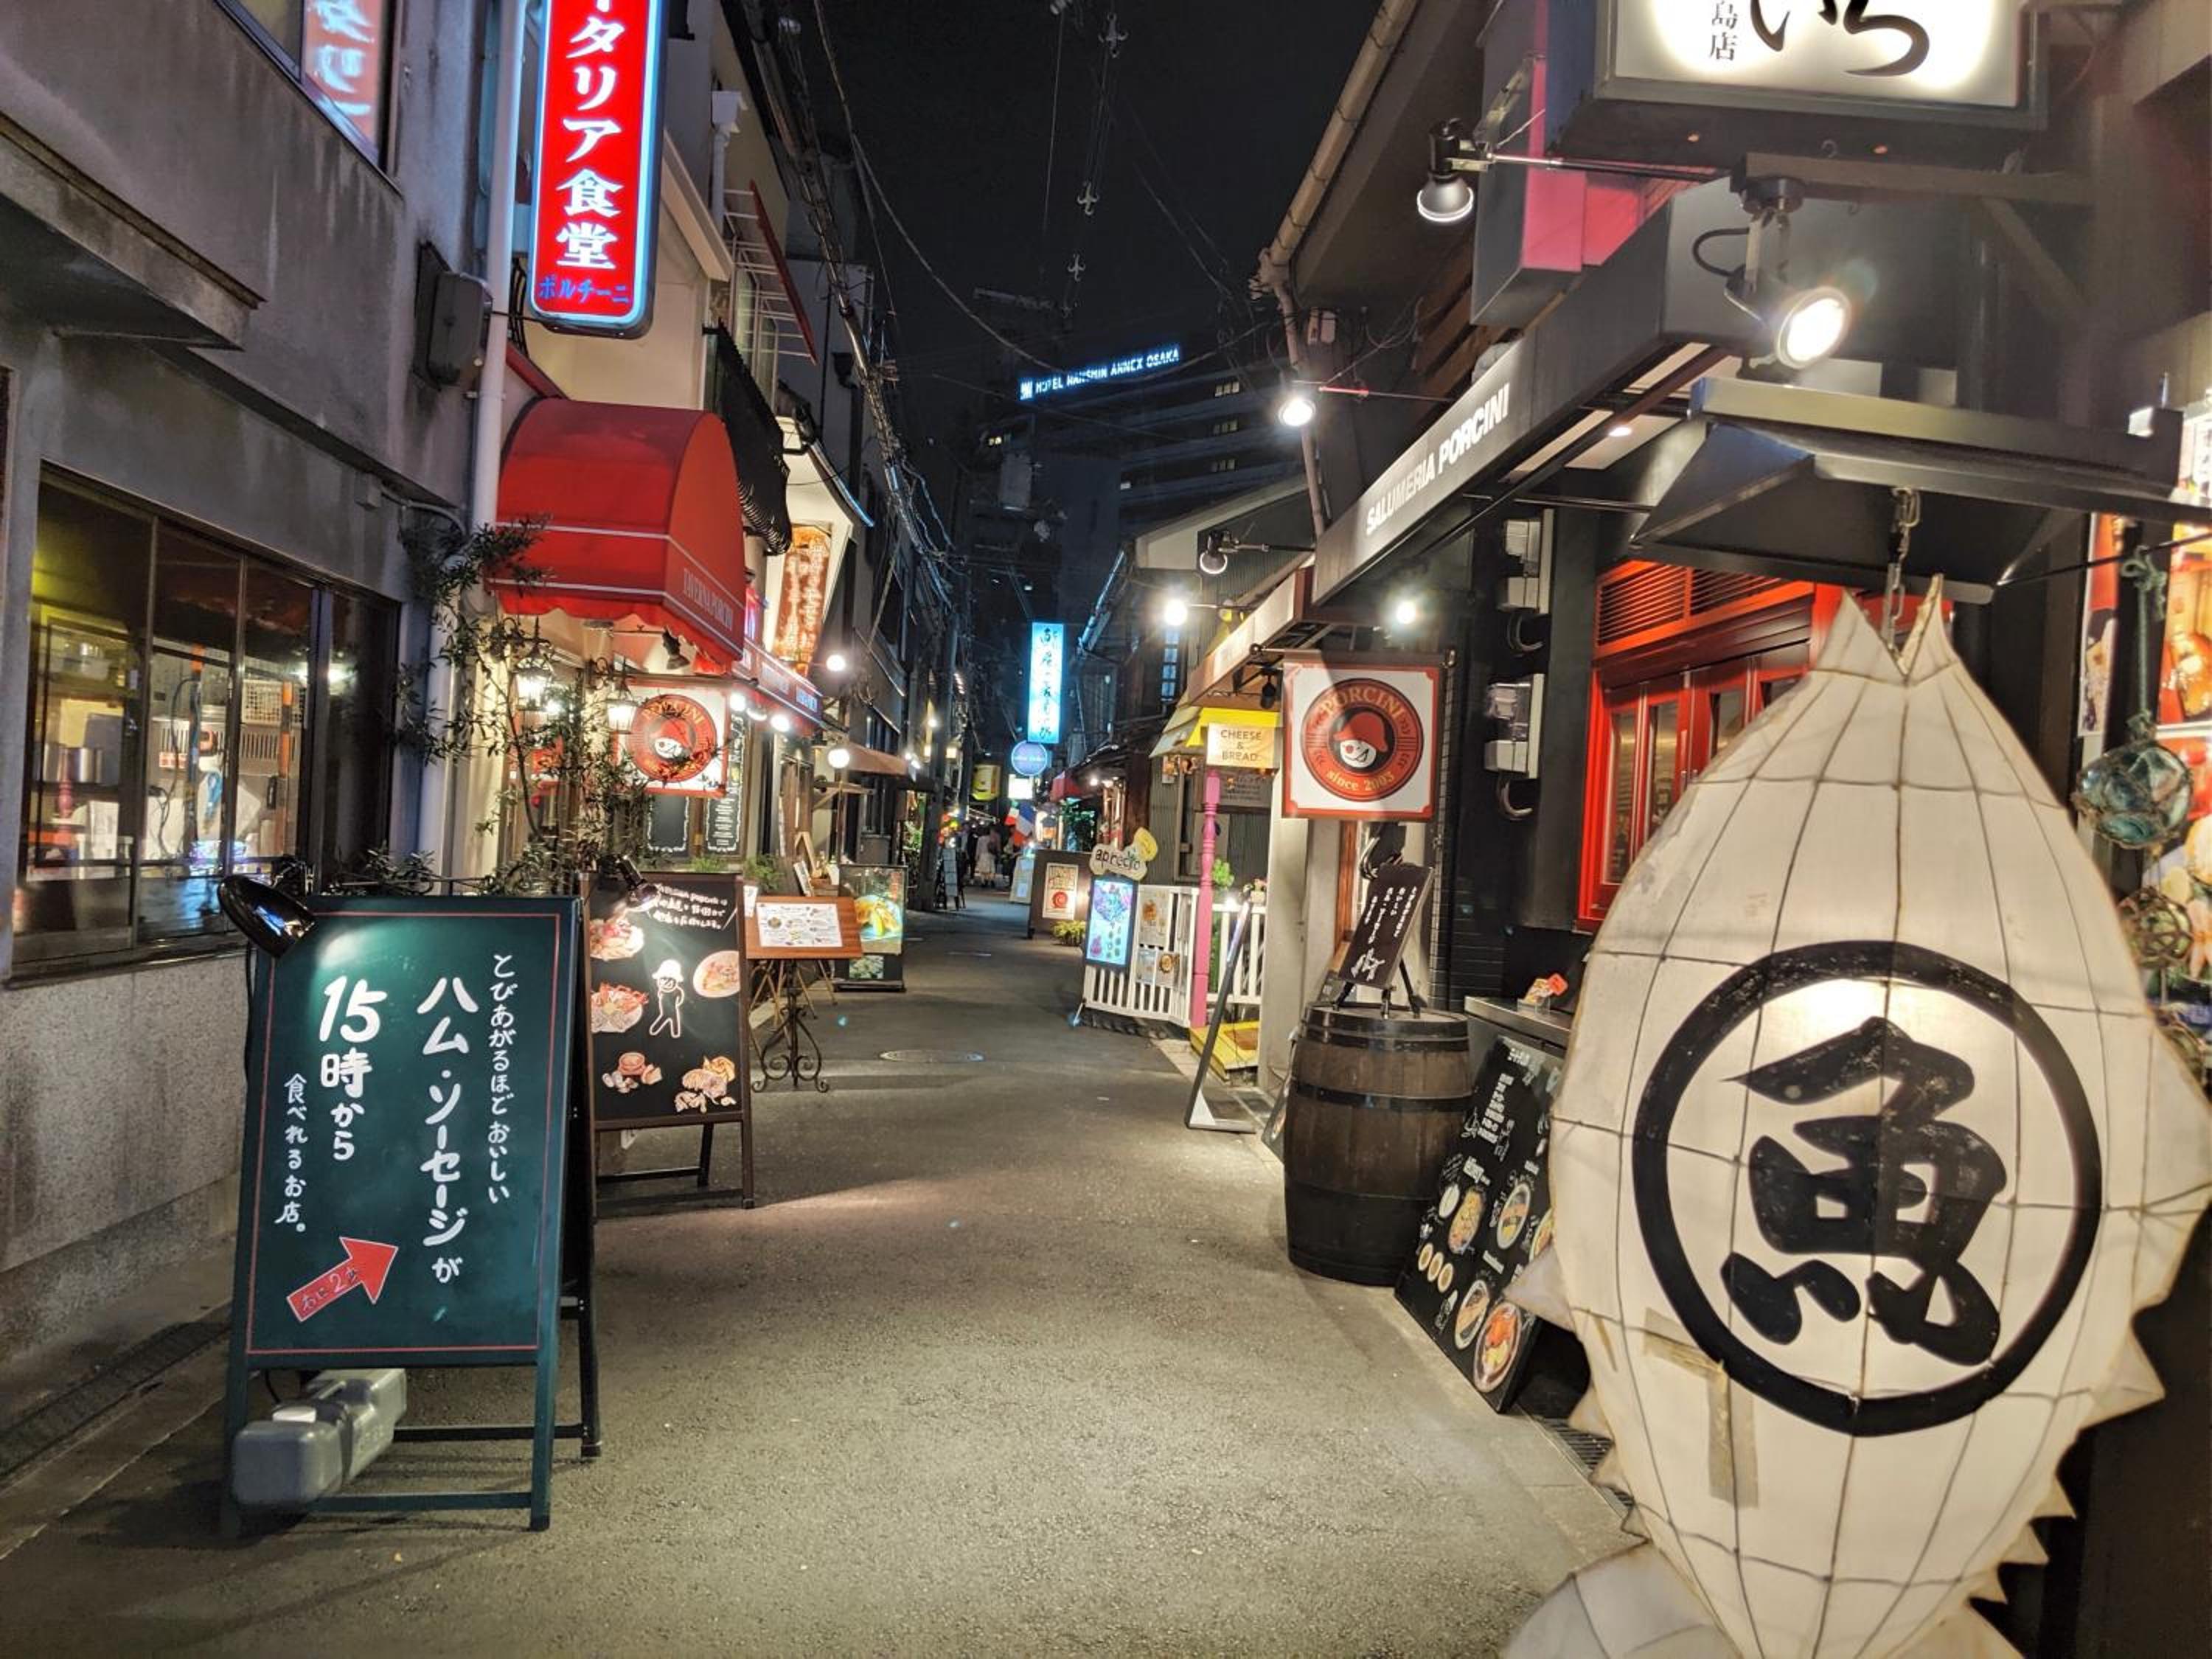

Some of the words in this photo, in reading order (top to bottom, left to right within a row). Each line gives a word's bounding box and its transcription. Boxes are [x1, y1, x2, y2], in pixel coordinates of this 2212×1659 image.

[555, 0, 626, 270] タリア食堂
[1036, 378, 1063, 393] HOTEL
[1110, 358, 1143, 375] ANNEX
[1146, 348, 1180, 367] OSAKA
[1366, 453, 1436, 536] SALUMERIA
[1438, 383, 1509, 474] PORCINI
[1321, 686, 1403, 720] PORCINI
[1220, 729, 1262, 741] CHEESE
[1237, 741, 1244, 750] &
[1222, 751, 1258, 762] BREAD
[1327, 770, 1359, 790] since
[319, 975, 388, 1161] 15時から
